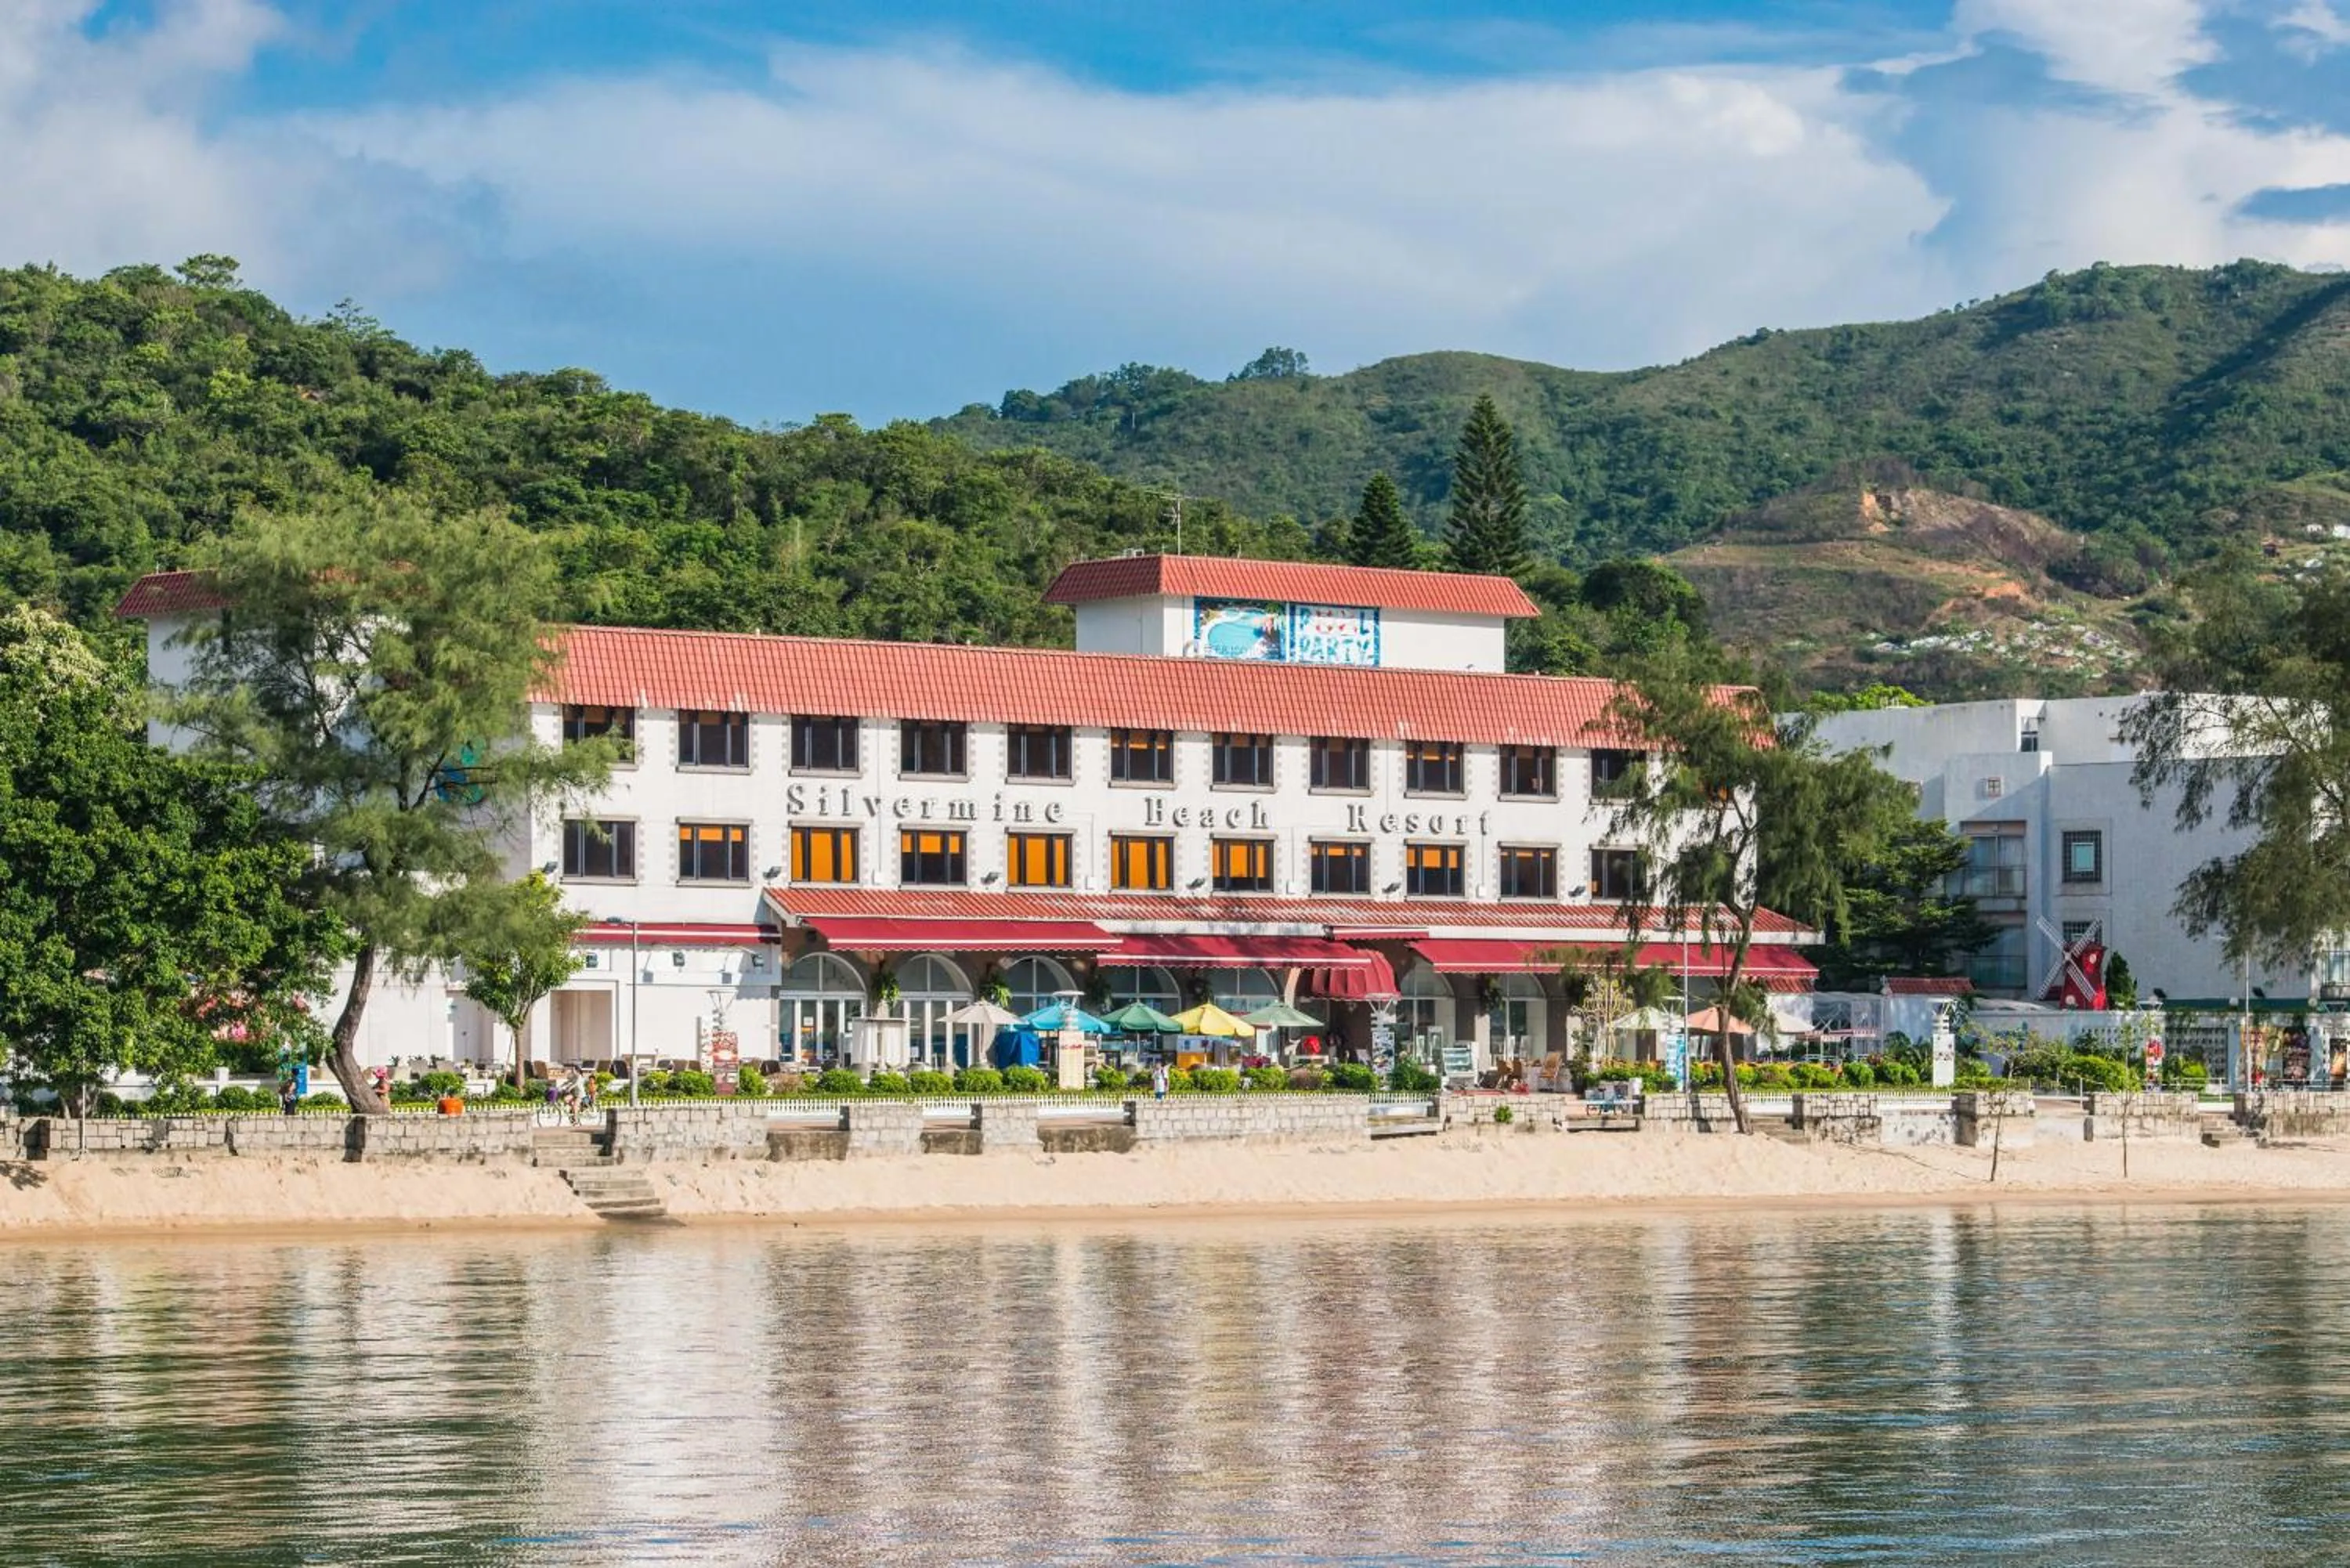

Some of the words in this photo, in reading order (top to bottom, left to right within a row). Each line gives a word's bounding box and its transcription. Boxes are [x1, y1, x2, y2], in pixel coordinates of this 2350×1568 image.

[786, 783, 1065, 822] Silvermine
[1144, 797, 1271, 829] Beach
[1347, 804, 1492, 835] Resort
